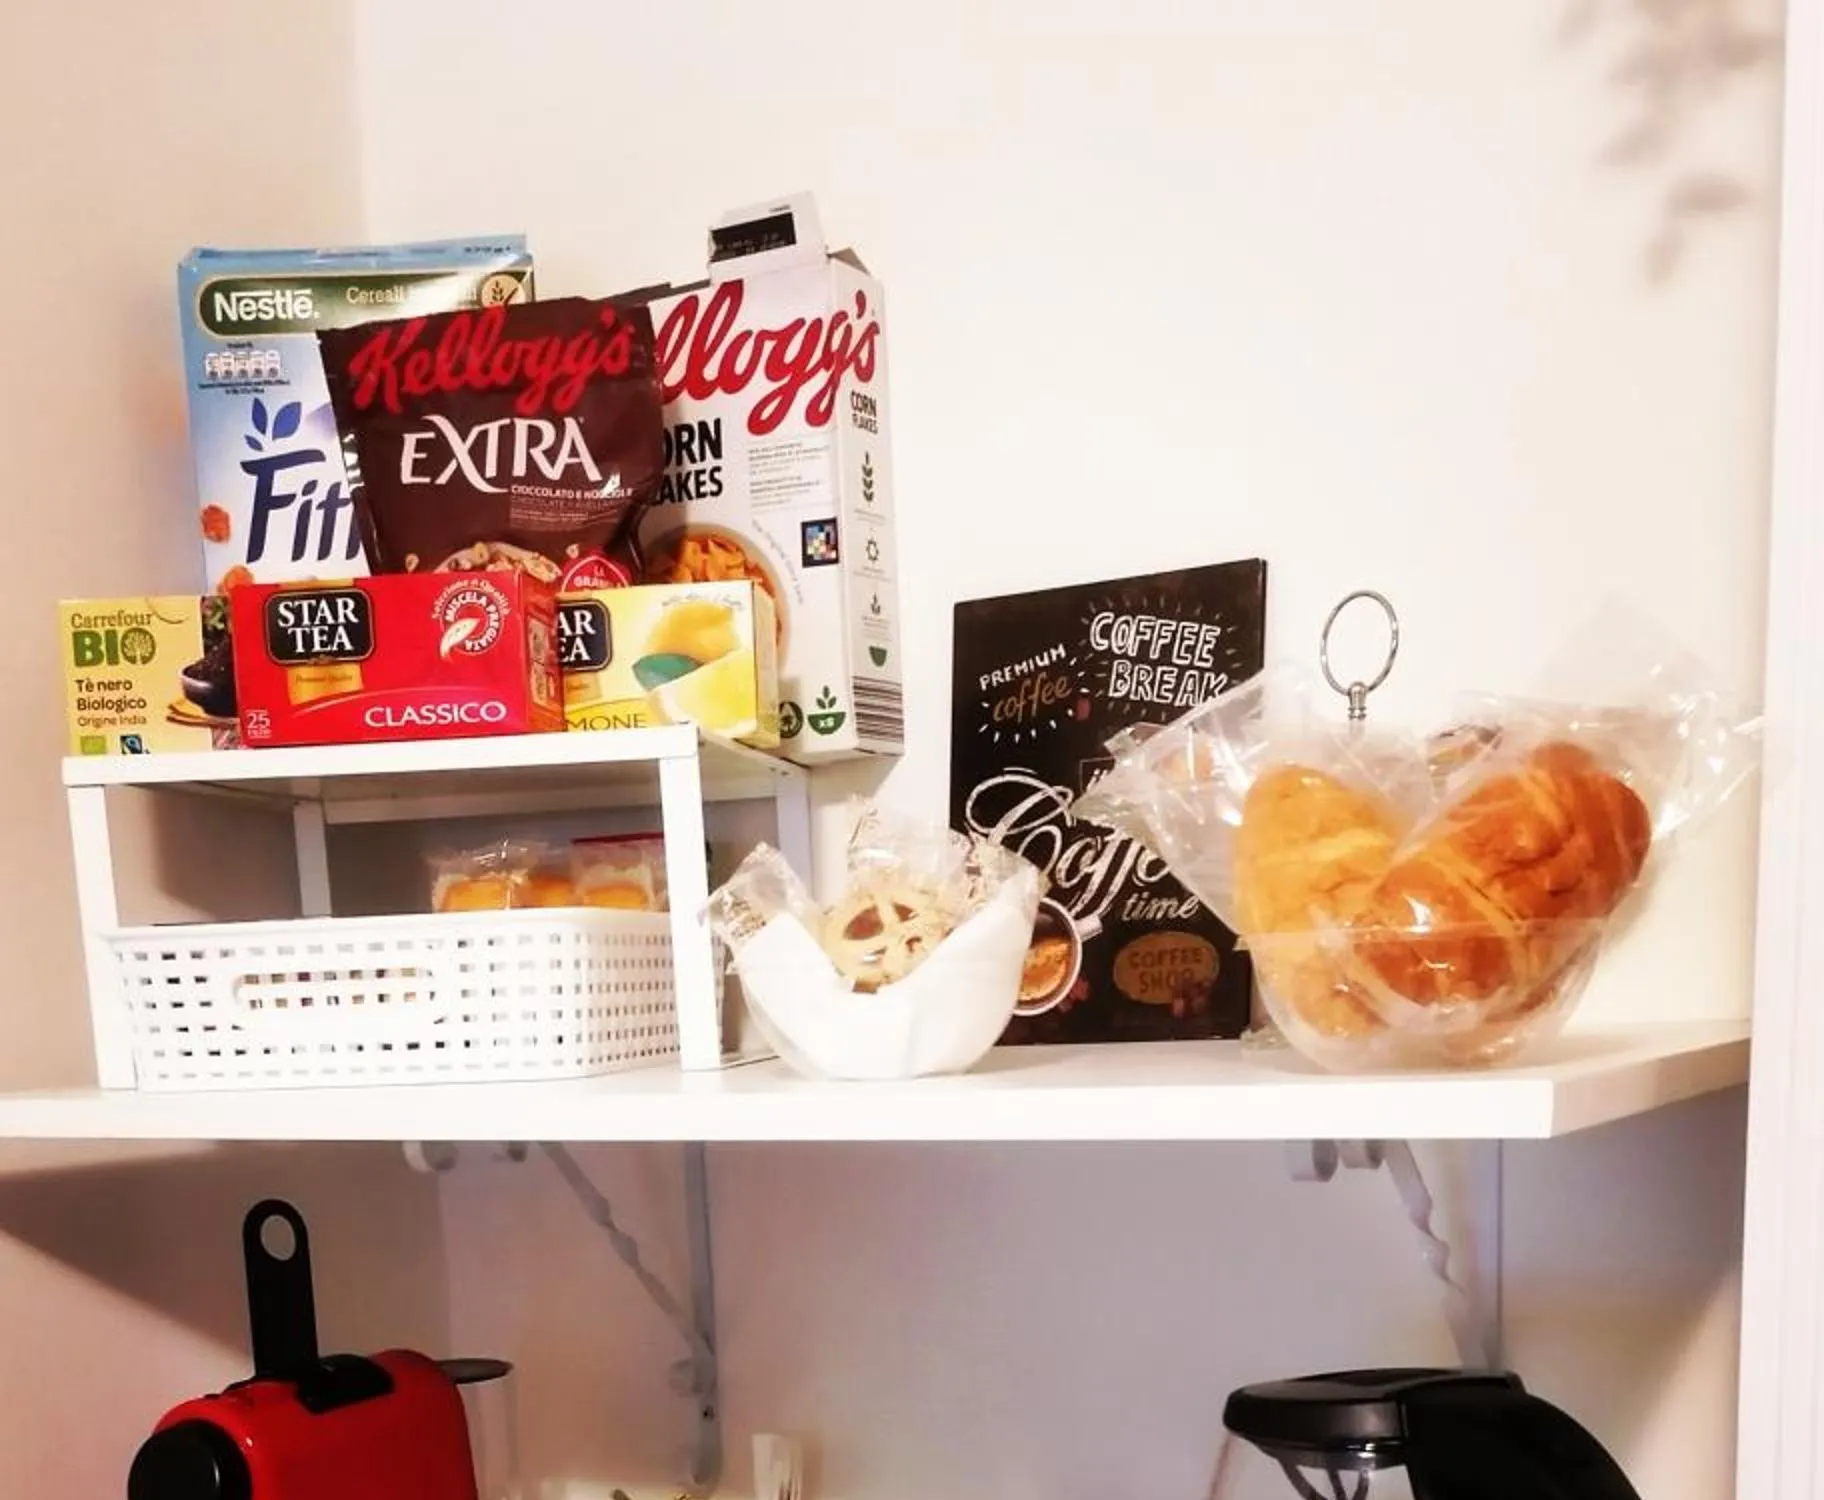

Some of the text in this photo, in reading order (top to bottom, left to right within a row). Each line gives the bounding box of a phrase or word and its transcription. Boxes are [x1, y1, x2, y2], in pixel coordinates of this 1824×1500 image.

[346, 303, 636, 415] Kellogg's
[655, 277, 881, 436] llogg's
[400, 413, 603, 493] EXTRA
[655, 465, 724, 506] AKES
[71, 609, 153, 629] Carrefour
[277, 596, 360, 628] STAR
[558, 609, 597, 637] AR
[72, 626, 156, 668] BIO
[287, 624, 354, 655] TEA
[559, 636, 592, 663] EA
[1089, 611, 1222, 669] COFFEE
[978, 642, 1067, 692] PREMIUM
[97, 679, 133, 691] nero
[993, 674, 1073, 724] coffee
[1108, 659, 1229, 708] BREAK
[77, 696, 147, 713] Biologico
[247, 711, 272, 729] 25
[364, 699, 508, 728] CLASSICO
[77, 714, 147, 729] Origine India
[564, 713, 648, 732] MONE
[1121, 891, 1200, 922] time
[1127, 946, 1203, 971] COFFEE
